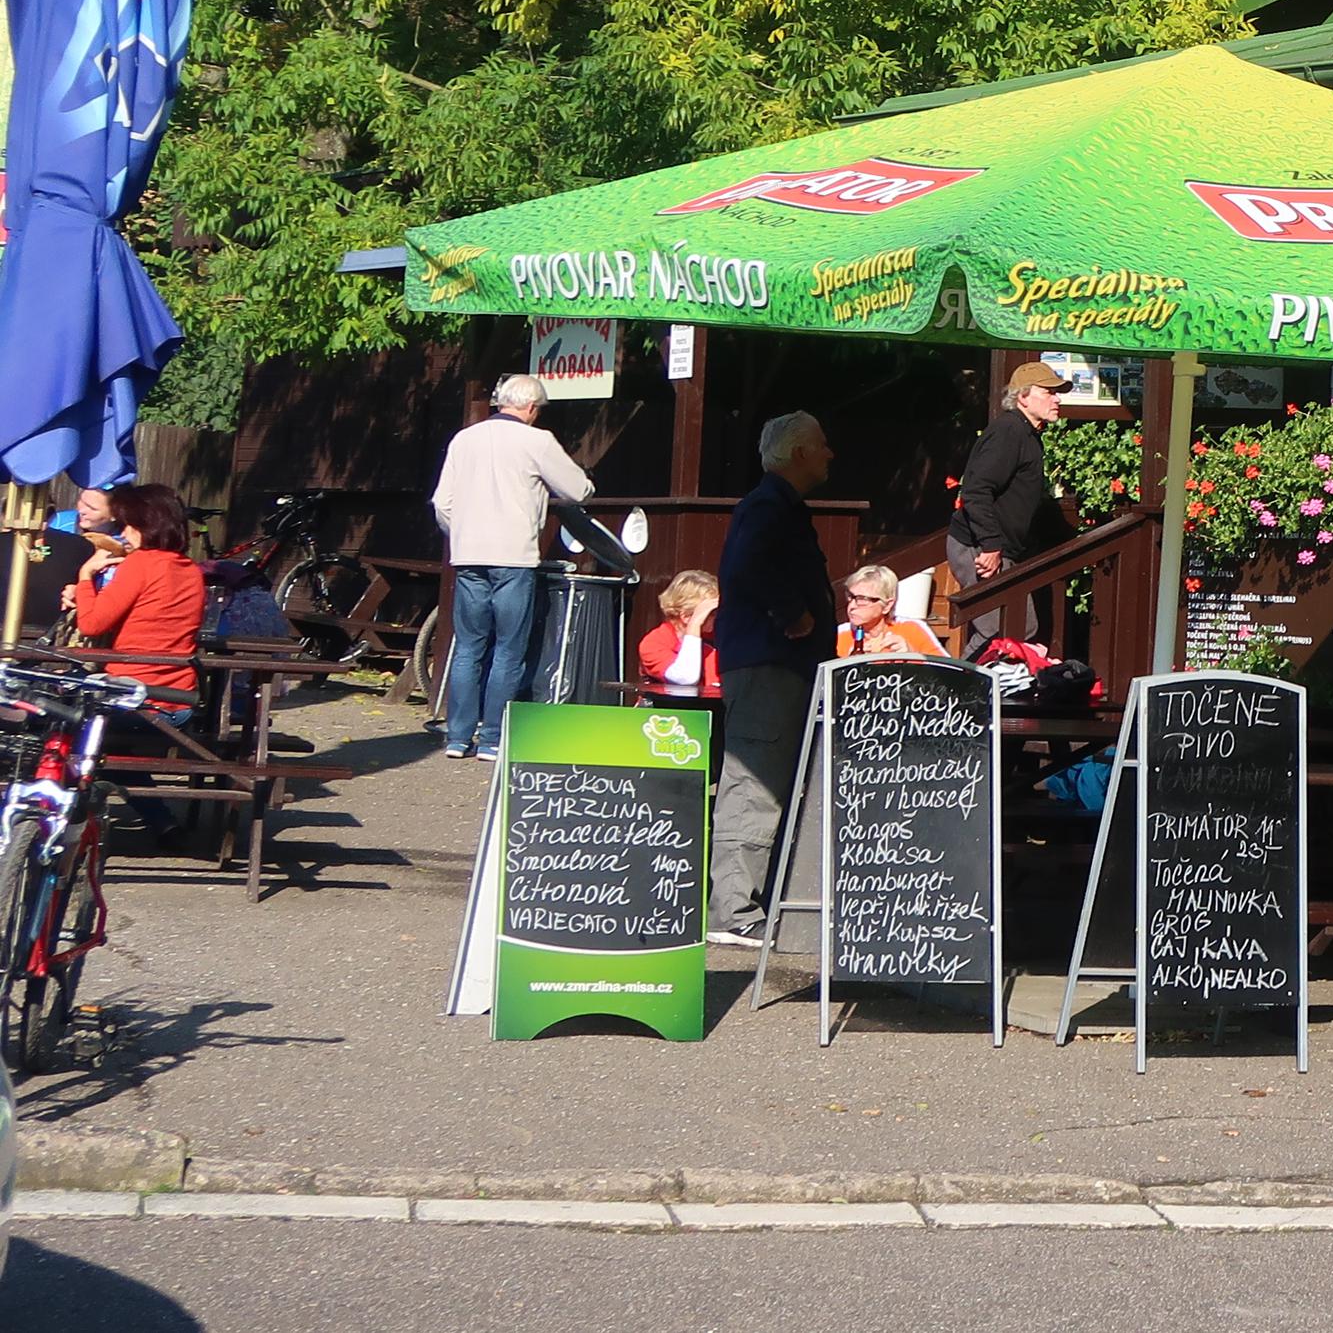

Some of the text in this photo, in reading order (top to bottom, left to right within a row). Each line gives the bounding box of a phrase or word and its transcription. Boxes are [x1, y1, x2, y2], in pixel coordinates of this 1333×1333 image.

[511, 250, 636, 301] PIVOVAR
[649, 240, 769, 309] NÁCHOD
[810, 246, 918, 302] Specialista
[997, 261, 1187, 313] Specialista
[834, 297, 851, 322] na
[854, 277, 914, 322] speciály
[1026, 295, 1179, 337] na speciály
[537, 344, 604, 380] KLOBÁSA
[845, 668, 914, 708] Grog
[1159, 684, 1281, 727] TOČENÉ
[848, 738, 902, 761] Pivo
[1163, 730, 1235, 759] PIVO
[521, 795, 652, 823] ZMRZLINA
[1148, 803, 1250, 841] PRIMÁTOR
[508, 819, 693, 849] Stracciatella
[839, 810, 917, 851] Langoš
[506, 846, 631, 873] Šmoulová
[841, 841, 944, 866] Klobása
[509, 874, 631, 906] Citronová
[836, 868, 954, 898] Hamburger
[1166, 888, 1283, 918] MALINOVKA
[509, 908, 617, 934] VARIEGATO
[1151, 909, 1212, 936] GROG
[839, 942, 971, 982] Hranolky
[530, 980, 673, 994] www.zmrzlina-misa.cz
